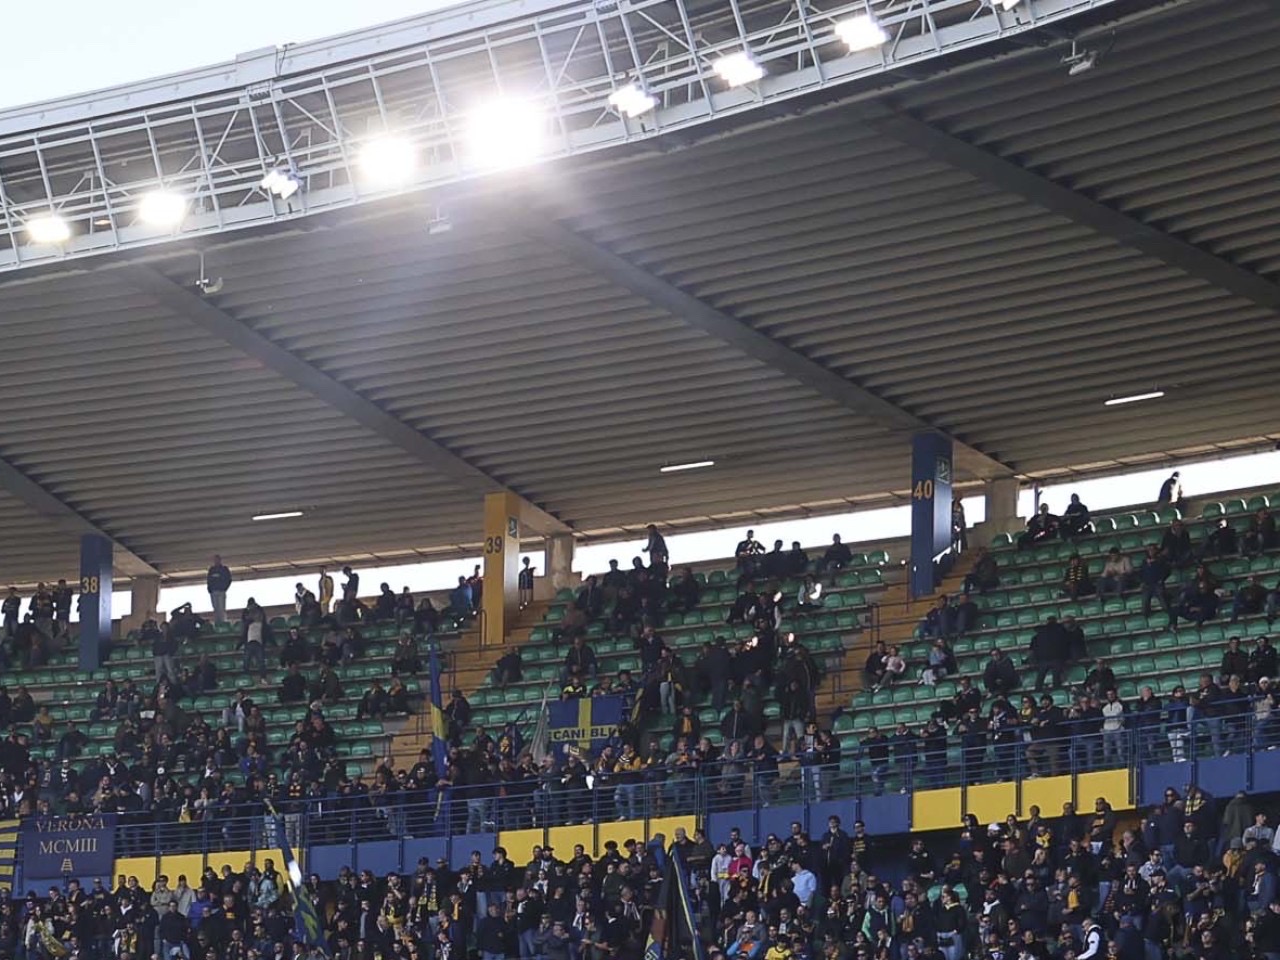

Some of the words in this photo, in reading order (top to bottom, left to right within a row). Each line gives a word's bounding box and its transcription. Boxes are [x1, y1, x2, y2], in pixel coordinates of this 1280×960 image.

[913, 479, 933, 499] 40
[486, 536, 503, 553] 39
[81, 576, 98, 593] 38
[553, 728, 586, 741] CANI
[36, 818, 105, 833] VERONA
[39, 838, 97, 854] MCMIII
